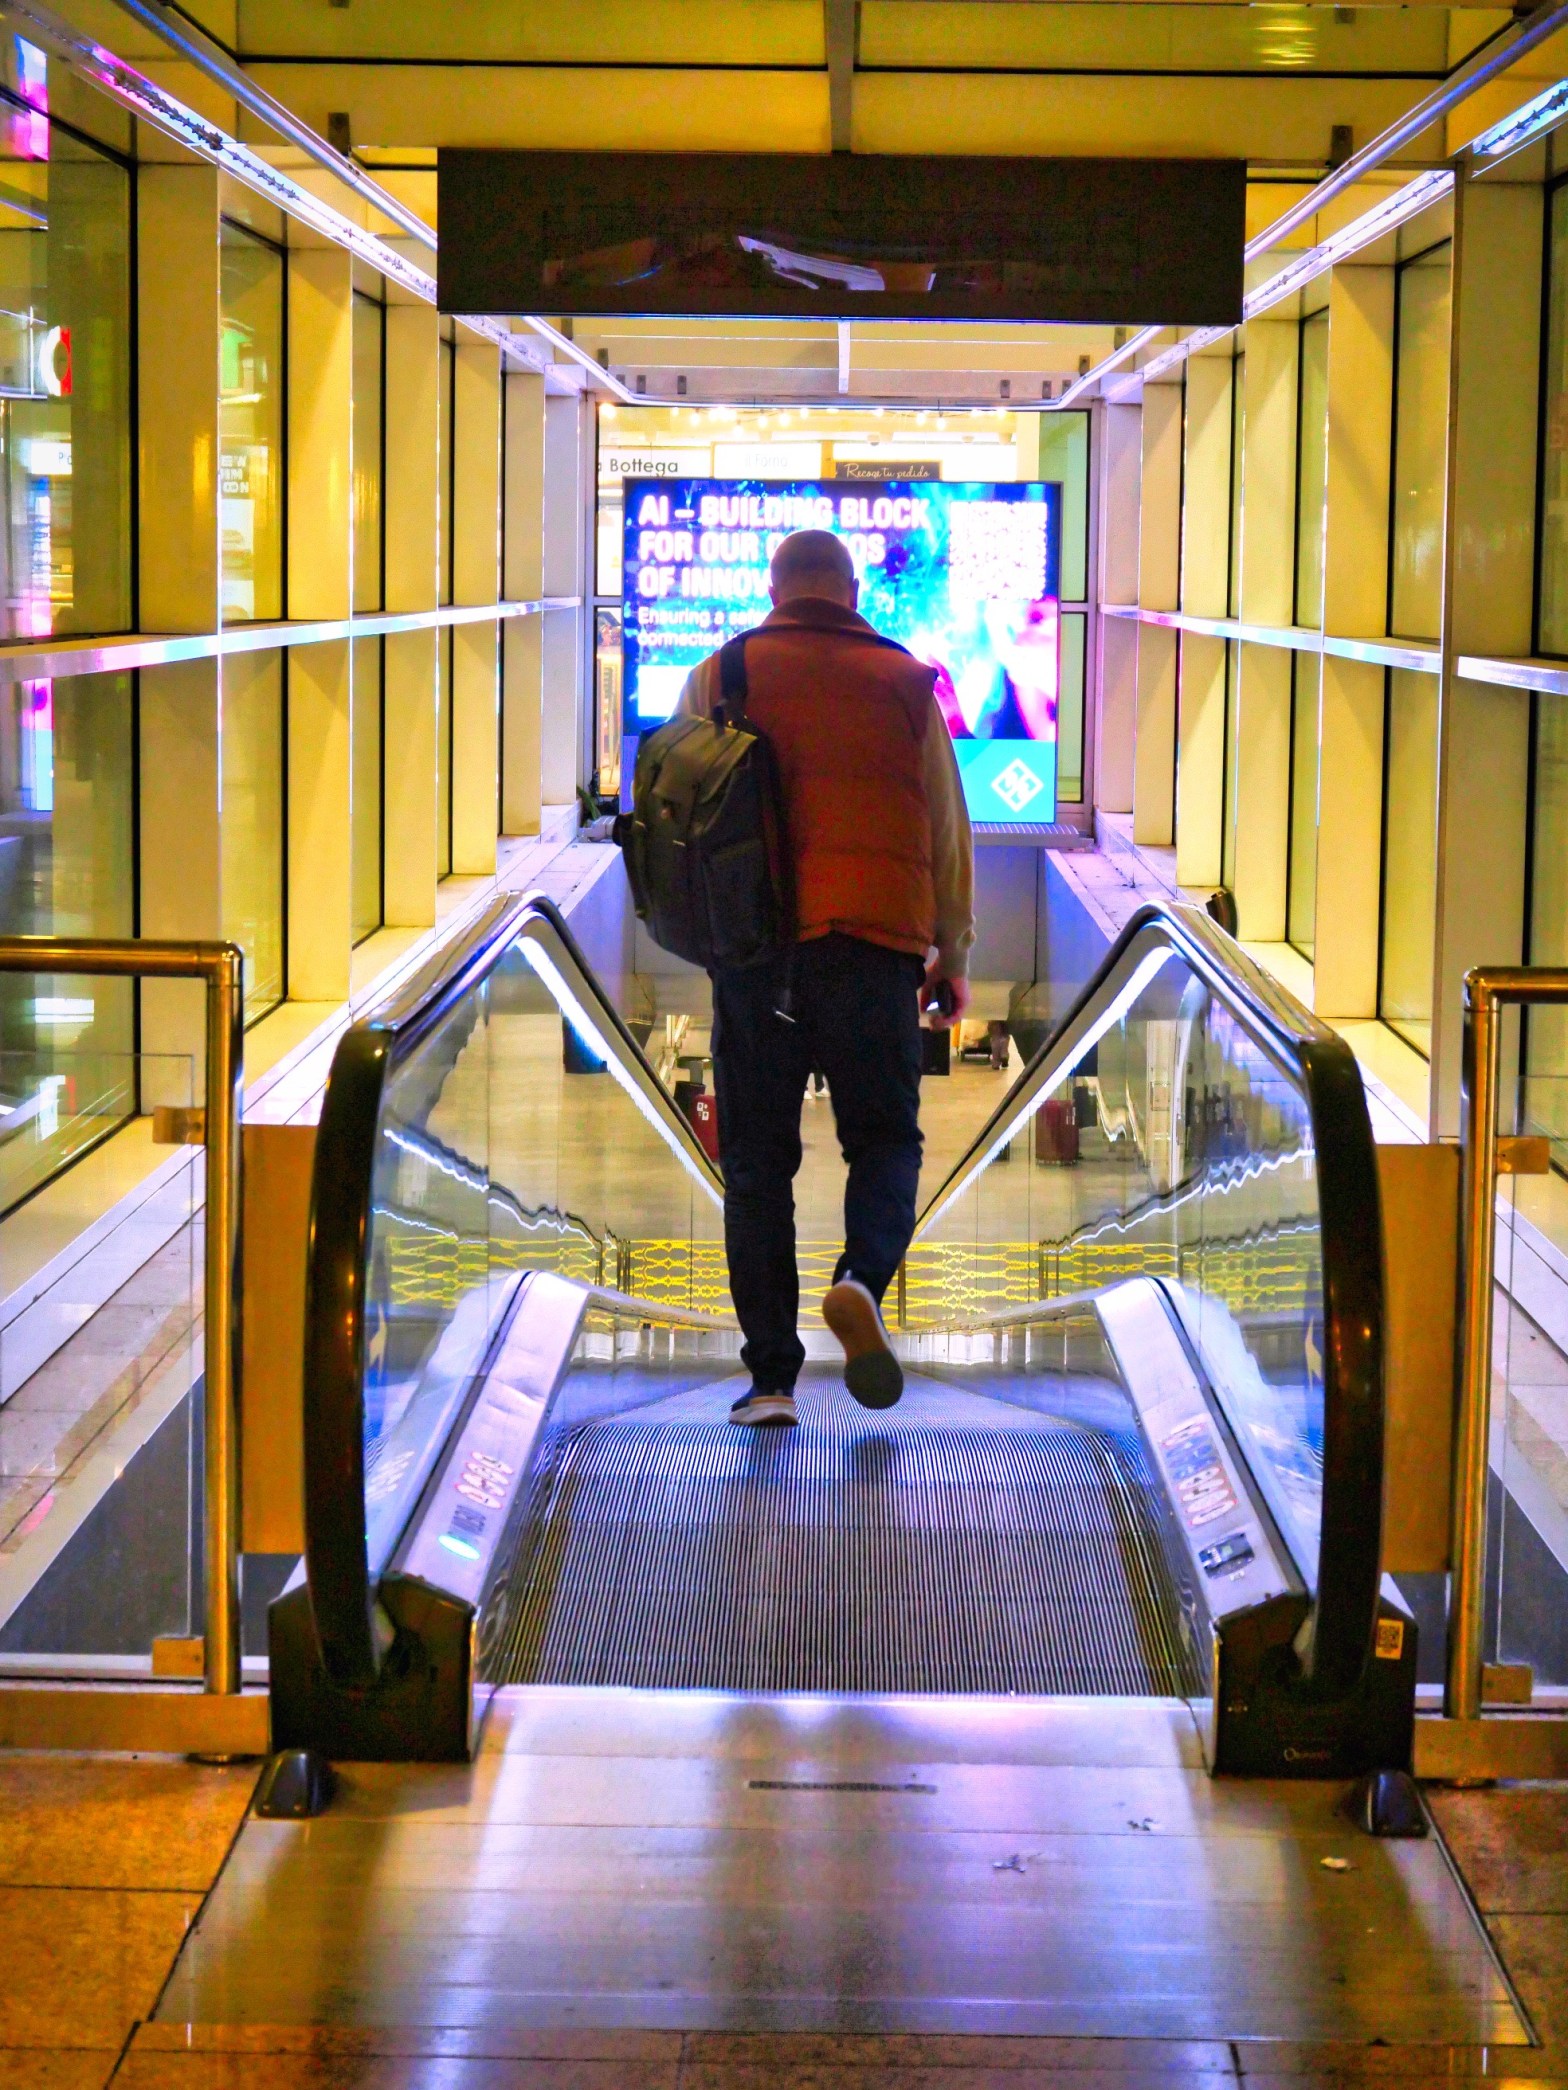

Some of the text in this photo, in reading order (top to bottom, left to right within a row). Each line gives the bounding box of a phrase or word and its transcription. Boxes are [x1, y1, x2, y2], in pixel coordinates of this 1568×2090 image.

[609, 458, 679, 476] Bottega
[844, 462, 930, 479] Recoge tu pedido
[638, 495, 669, 526] AI
[700, 496, 834, 528] BUILDING
[840, 497, 930, 529] BLOCK
[638, 531, 886, 565] FOR OUR COS
[637, 566, 772, 598] OF INNOV
[637, 606, 711, 628] Ensuring
[714, 611, 726, 625] a
[637, 630, 725, 647] connected
